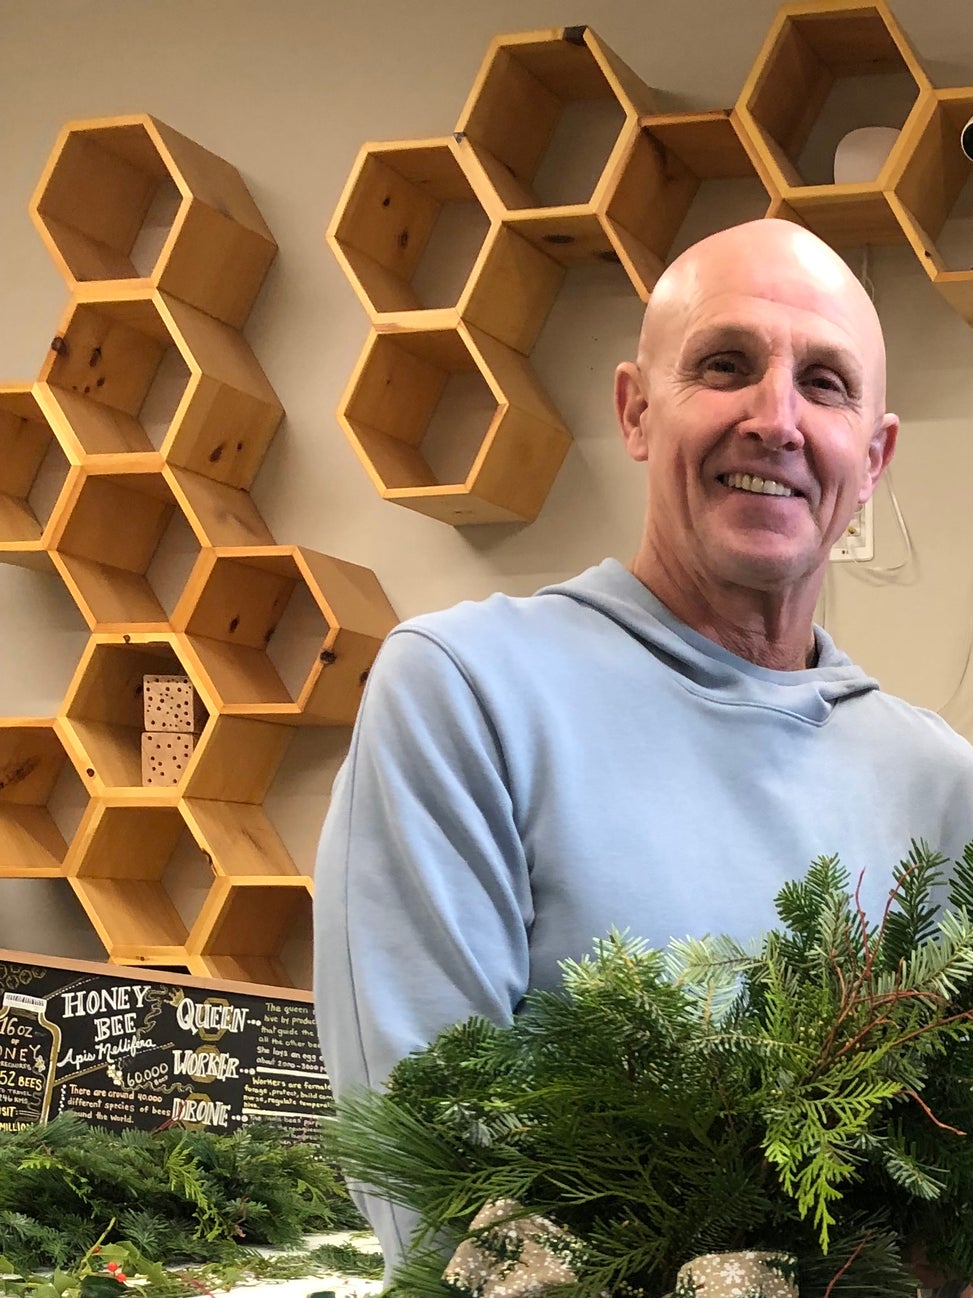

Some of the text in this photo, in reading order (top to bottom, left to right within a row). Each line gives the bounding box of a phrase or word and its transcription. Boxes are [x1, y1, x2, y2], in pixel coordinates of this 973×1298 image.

[61, 985, 151, 1018] HONEY
[265, 1002, 281, 1012] The
[284, 1006, 308, 1014] queen
[176, 997, 249, 1035] QUEEN
[292, 1017, 317, 1026] produc
[0, 1016, 18, 1035] 16
[94, 1012, 137, 1042] BEE
[285, 1039, 305, 1047] other
[56, 1048, 96, 1070] Apis
[256, 1046, 270, 1054] She
[272, 1047, 288, 1057] lays
[302, 1053, 317, 1062] egg
[172, 1049, 240, 1082] WORKER
[18, 1076, 43, 1091] BEES
[252, 1076, 286, 1087] Workers
[69, 1084, 90, 1096] There
[93, 1089, 106, 1097] are
[107, 1089, 135, 1100] around
[67, 1096, 172, 1117] different species of bees
[171, 1097, 231, 1128] DRONE
[95, 1111, 108, 1120] the
